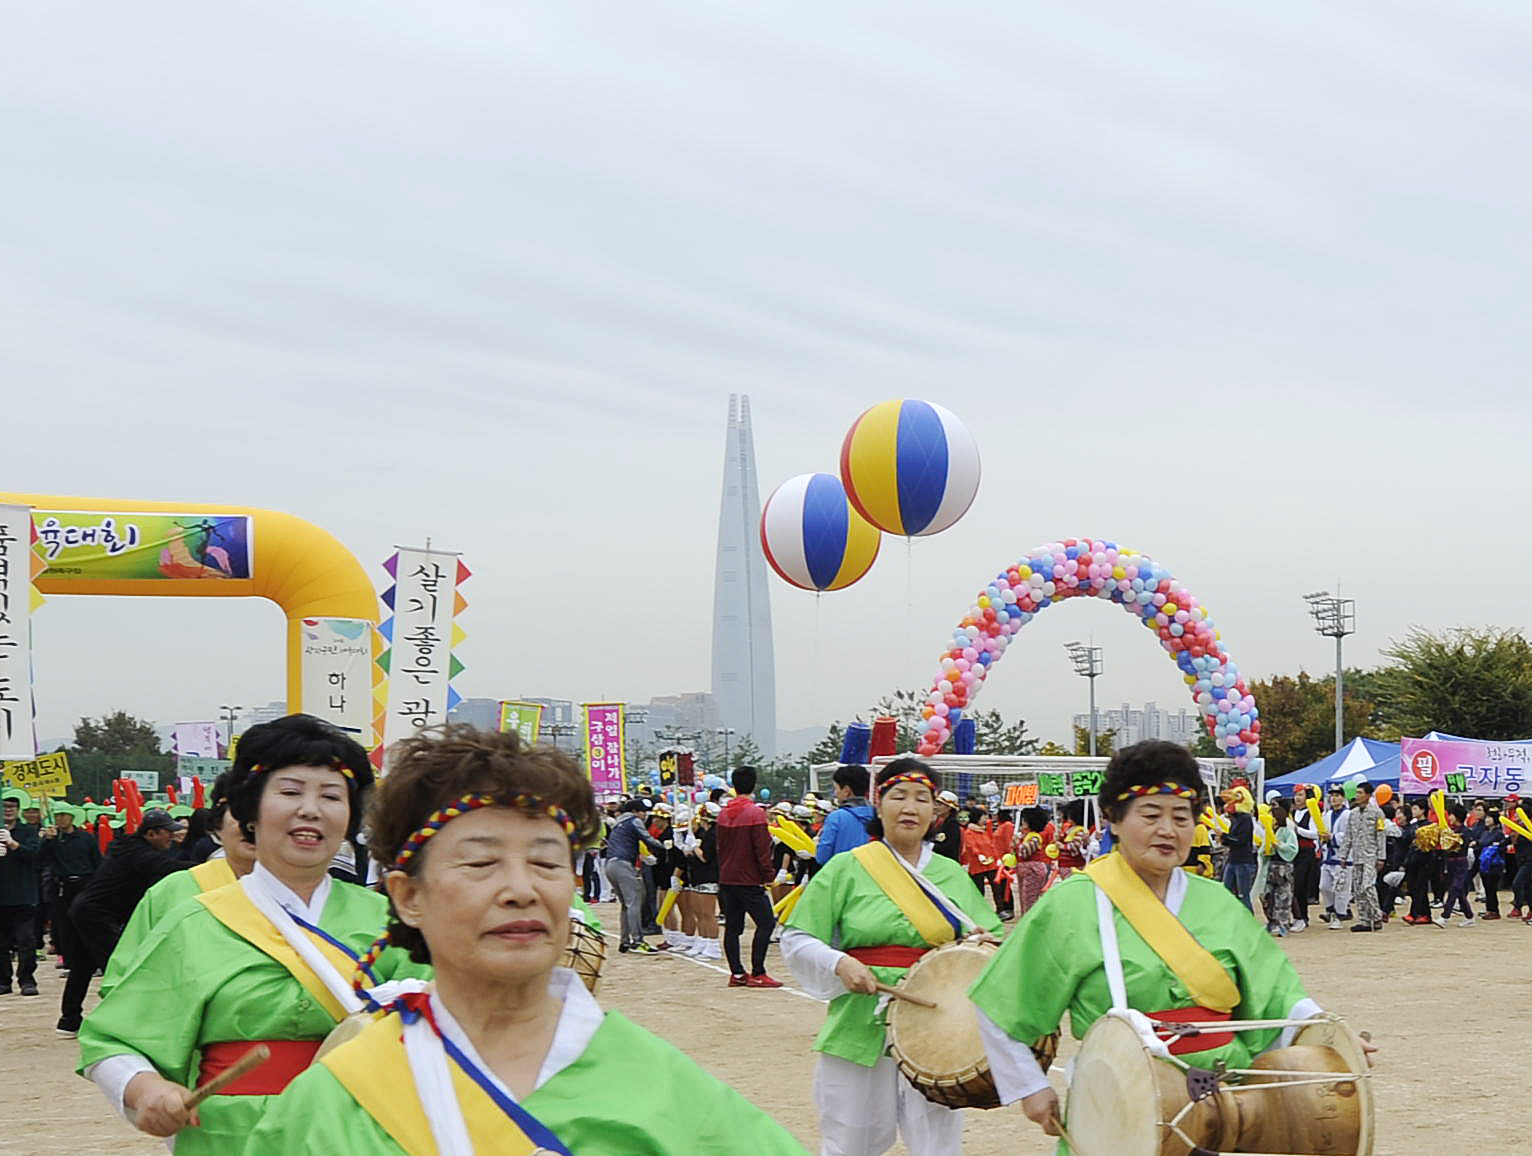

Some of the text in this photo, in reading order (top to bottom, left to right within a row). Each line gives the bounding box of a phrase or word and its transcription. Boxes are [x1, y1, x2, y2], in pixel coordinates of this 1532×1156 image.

[12, 756, 68, 782] 경제도시
[1416, 755, 1433, 778] 필
[1457, 765, 1526, 793] 군자동
